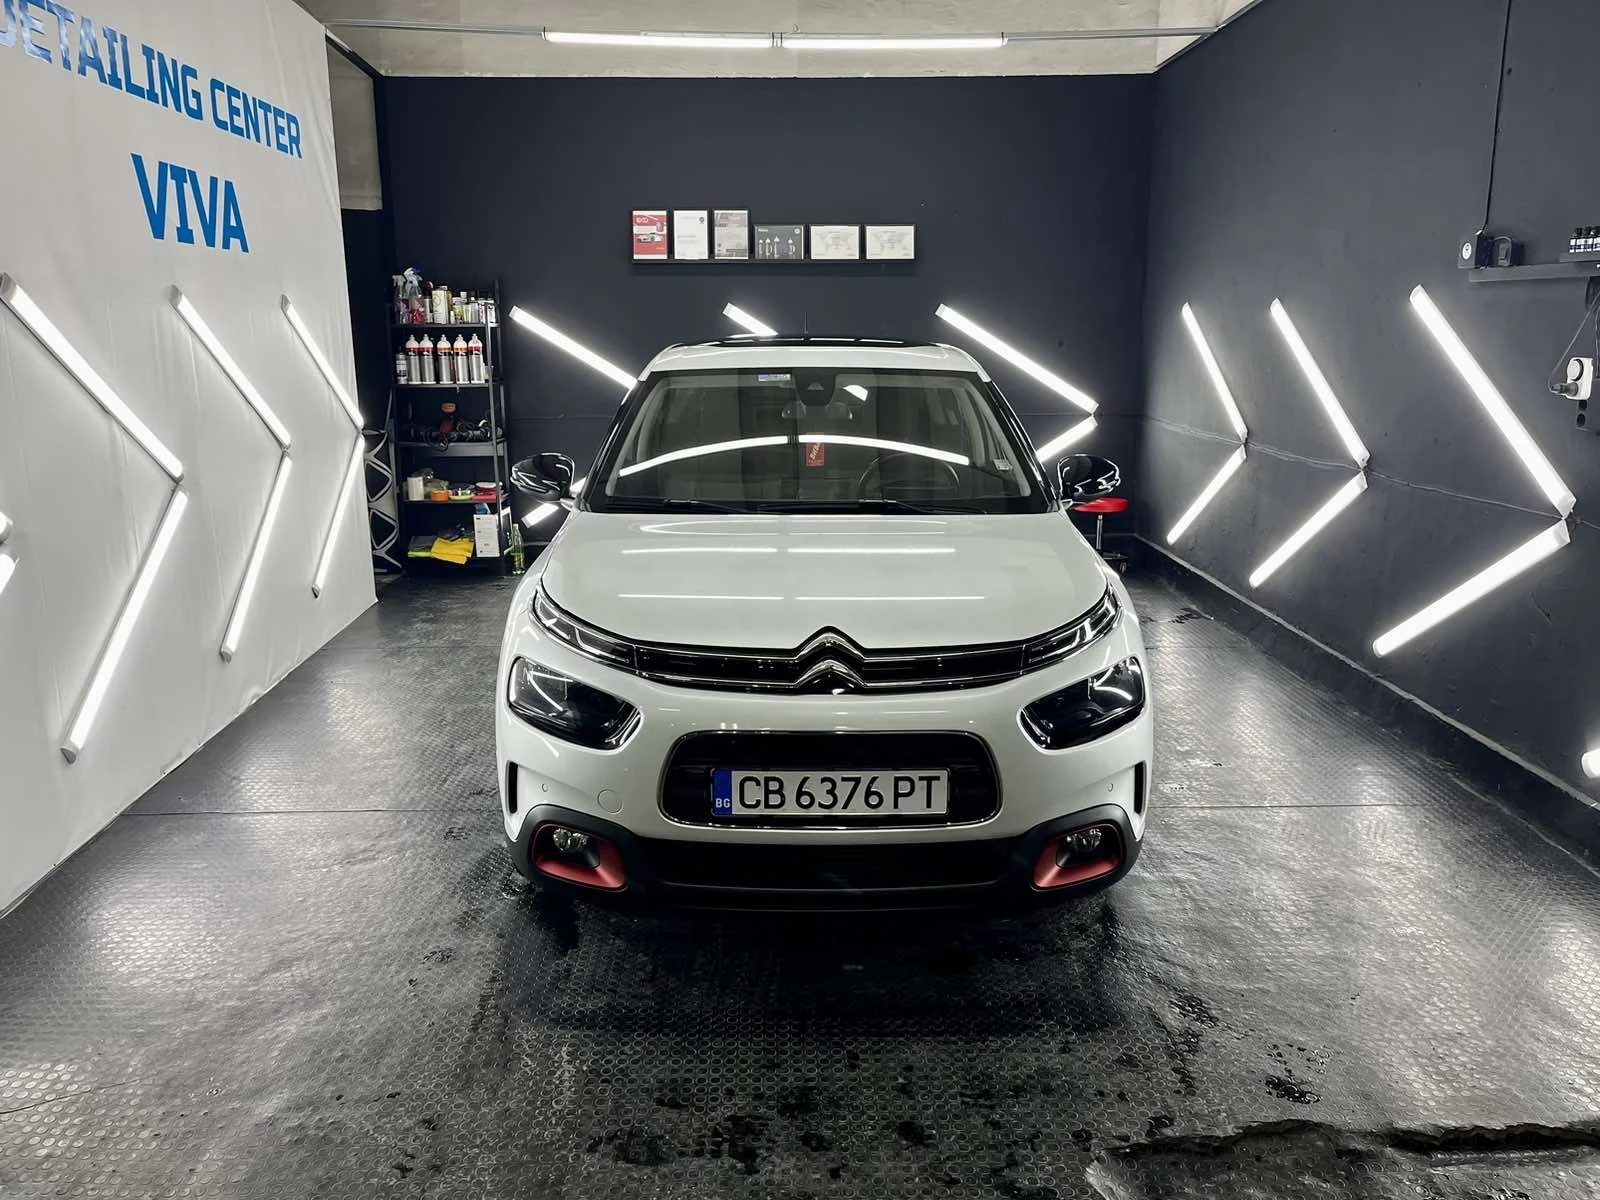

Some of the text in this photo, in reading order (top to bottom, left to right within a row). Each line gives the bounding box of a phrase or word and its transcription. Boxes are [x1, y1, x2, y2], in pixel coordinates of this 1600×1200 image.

[209, 77, 302, 158] CENTER
[130, 152, 250, 253] VIVA
[715, 798, 731, 809] BG
[738, 775, 942, 810] CB 6376 PT
